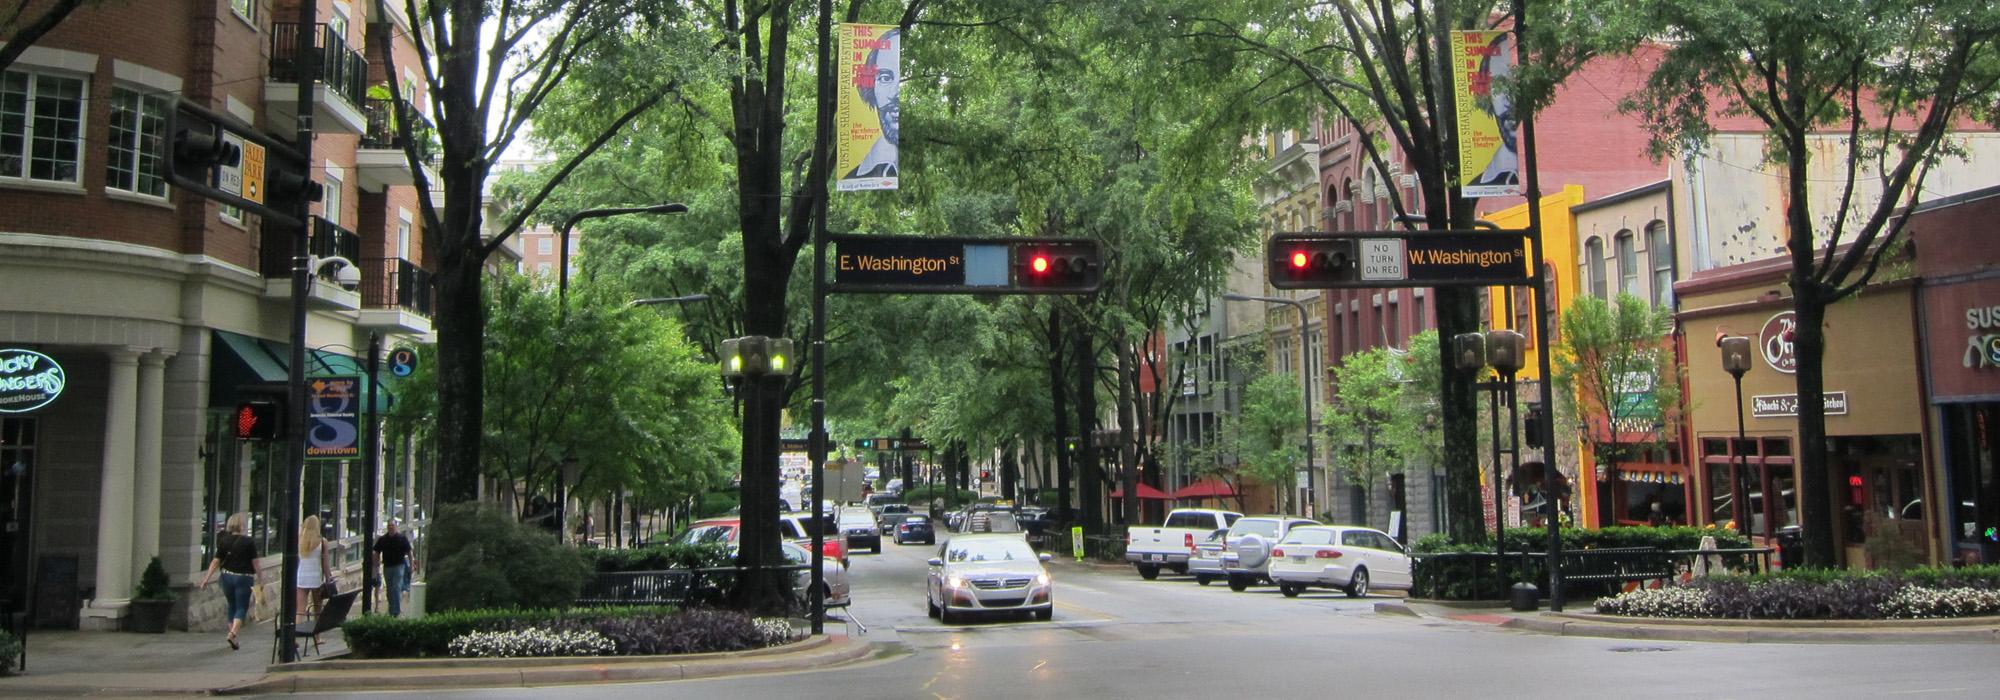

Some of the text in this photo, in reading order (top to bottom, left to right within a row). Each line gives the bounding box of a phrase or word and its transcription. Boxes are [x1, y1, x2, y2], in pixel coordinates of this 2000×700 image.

[853, 26, 873, 36] THIS
[1464, 33, 1483, 43] THIS
[853, 39, 892, 49] SUMMER
[853, 52, 862, 61] IN
[1466, 59, 1476, 69] IN
[840, 27, 852, 169] UPSTATE SHAKESPEARE FESTIVAL
[1454, 35, 1473, 176] UPSTATE SHAKESPEARE FESTIVAL
[246, 143, 264, 163] FALLS
[244, 160, 262, 181] PARK
[231, 173, 240, 187] RED
[1374, 244, 1389, 252] NO
[1370, 255, 1394, 263] TURN
[1409, 249, 1425, 265] W.
[1428, 248, 1511, 268] Washington
[840, 254, 959, 275] E. Washington St
[1366, 265, 1399, 274] ON RED
[1823, 397, 1844, 409] itchen
[307, 446, 357, 455] downtown
